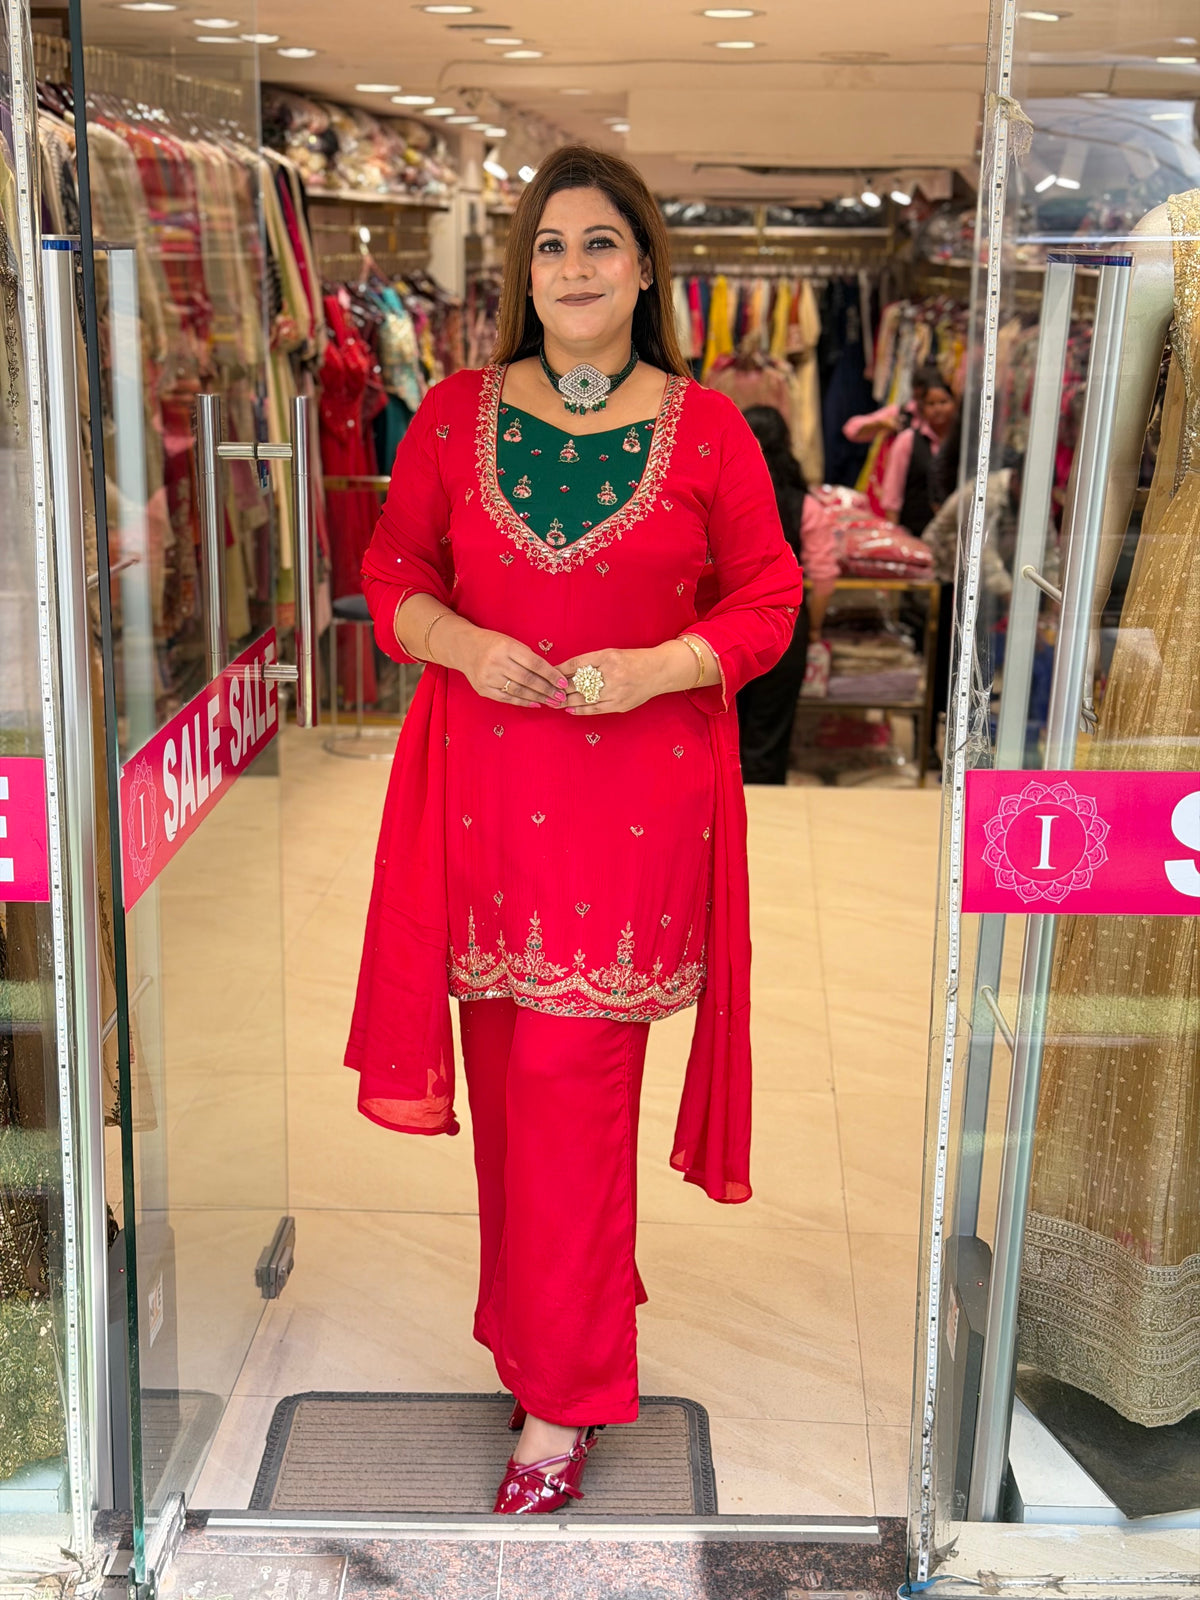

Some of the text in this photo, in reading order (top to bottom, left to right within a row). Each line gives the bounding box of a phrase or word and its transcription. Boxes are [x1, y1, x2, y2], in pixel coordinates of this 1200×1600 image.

[163, 642, 277, 842] SALE SALE
[1032, 815, 1060, 870] I
